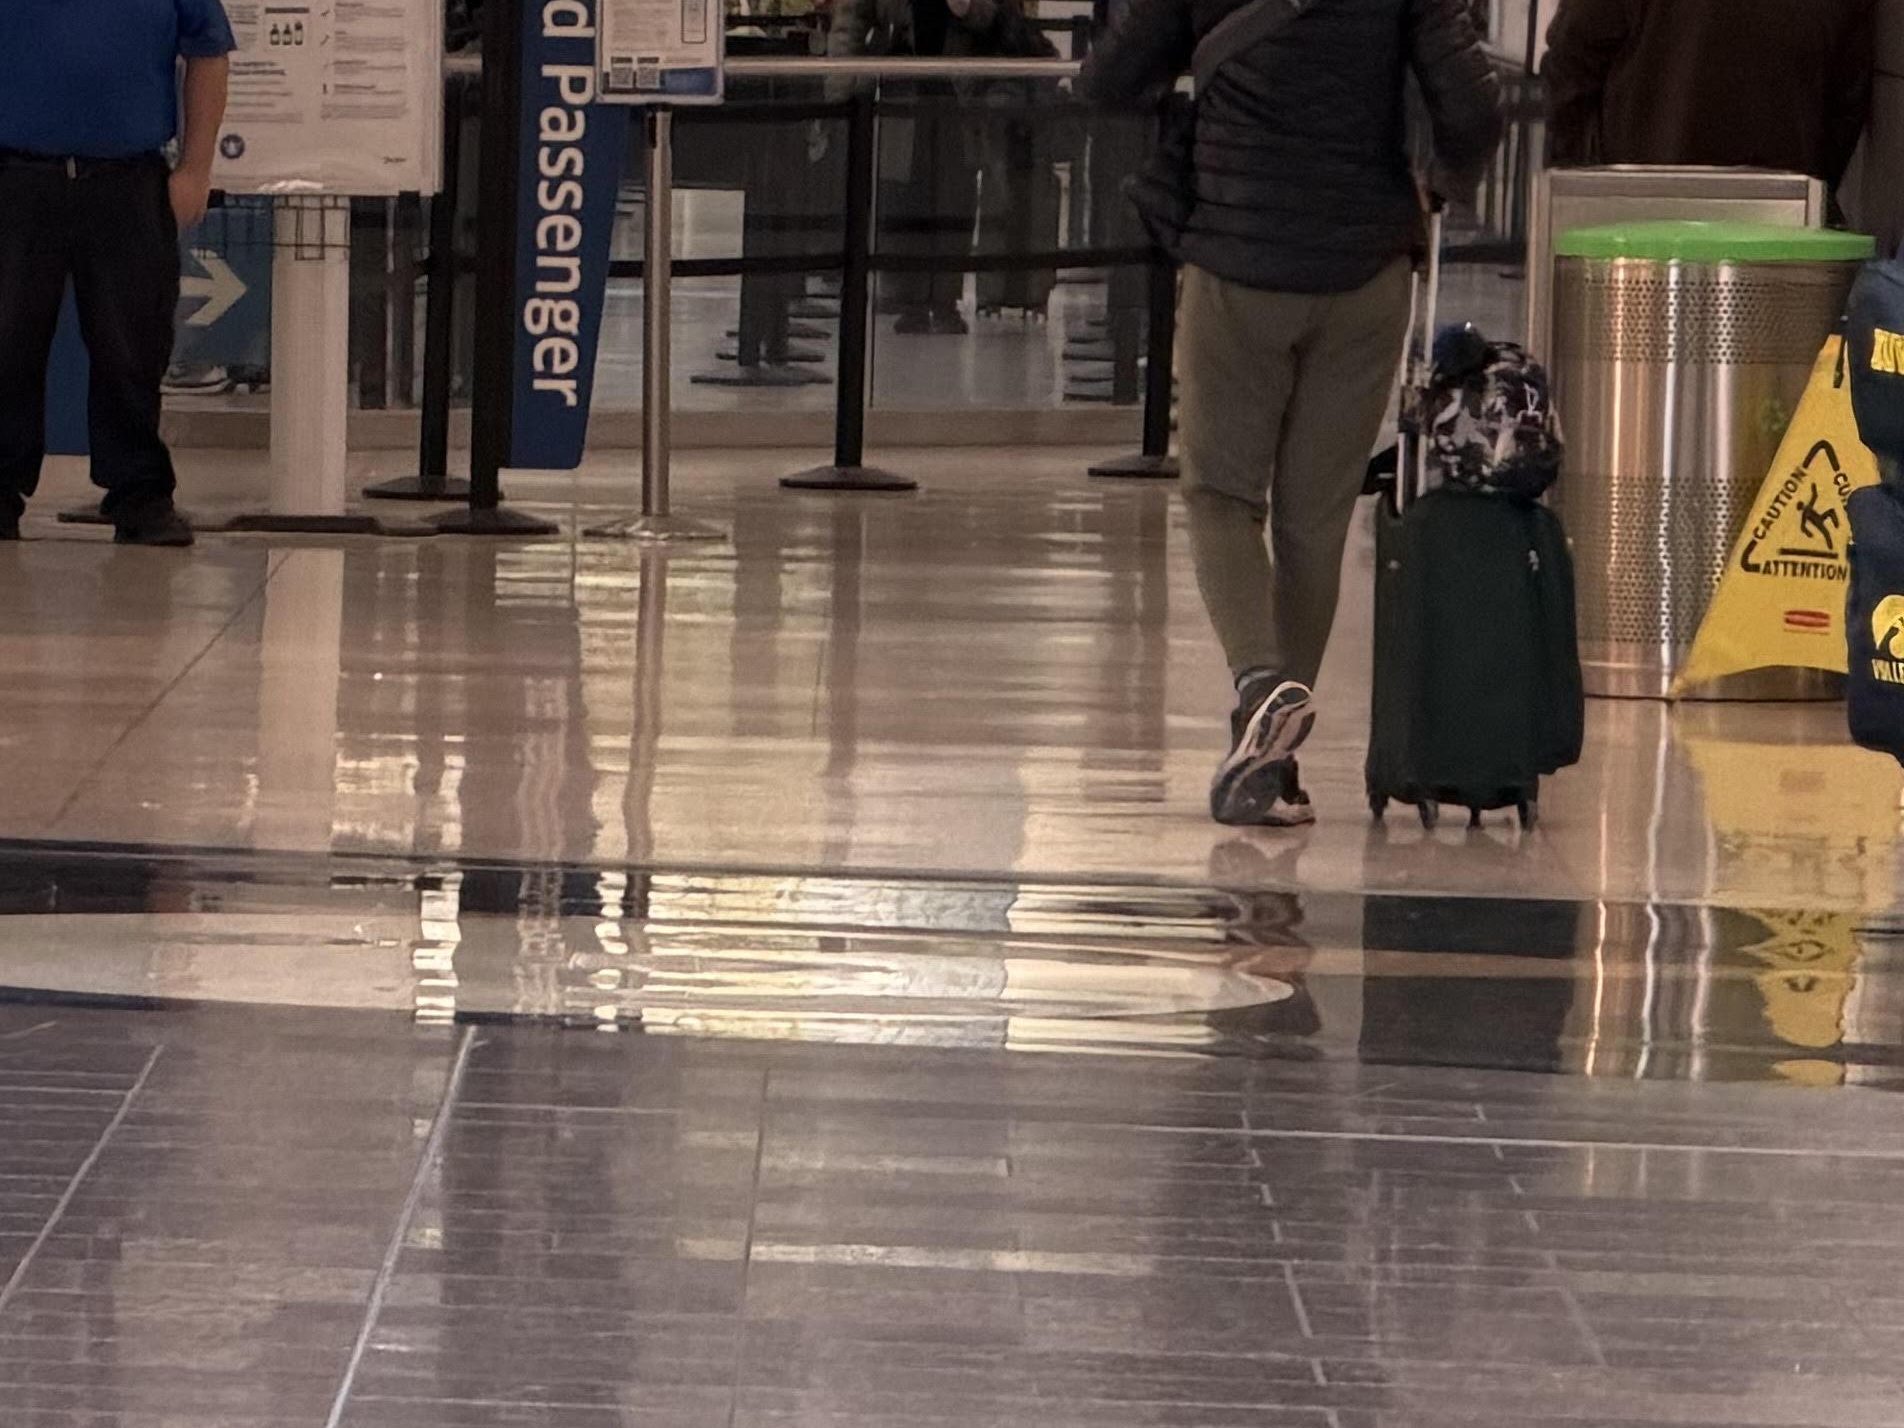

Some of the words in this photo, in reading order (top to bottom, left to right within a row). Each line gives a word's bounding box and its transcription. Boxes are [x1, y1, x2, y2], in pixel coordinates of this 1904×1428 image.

[524, 64, 596, 407] Passenger
[1753, 465, 1808, 540] CAUTION
[1762, 559, 1848, 581] ATTENTION
